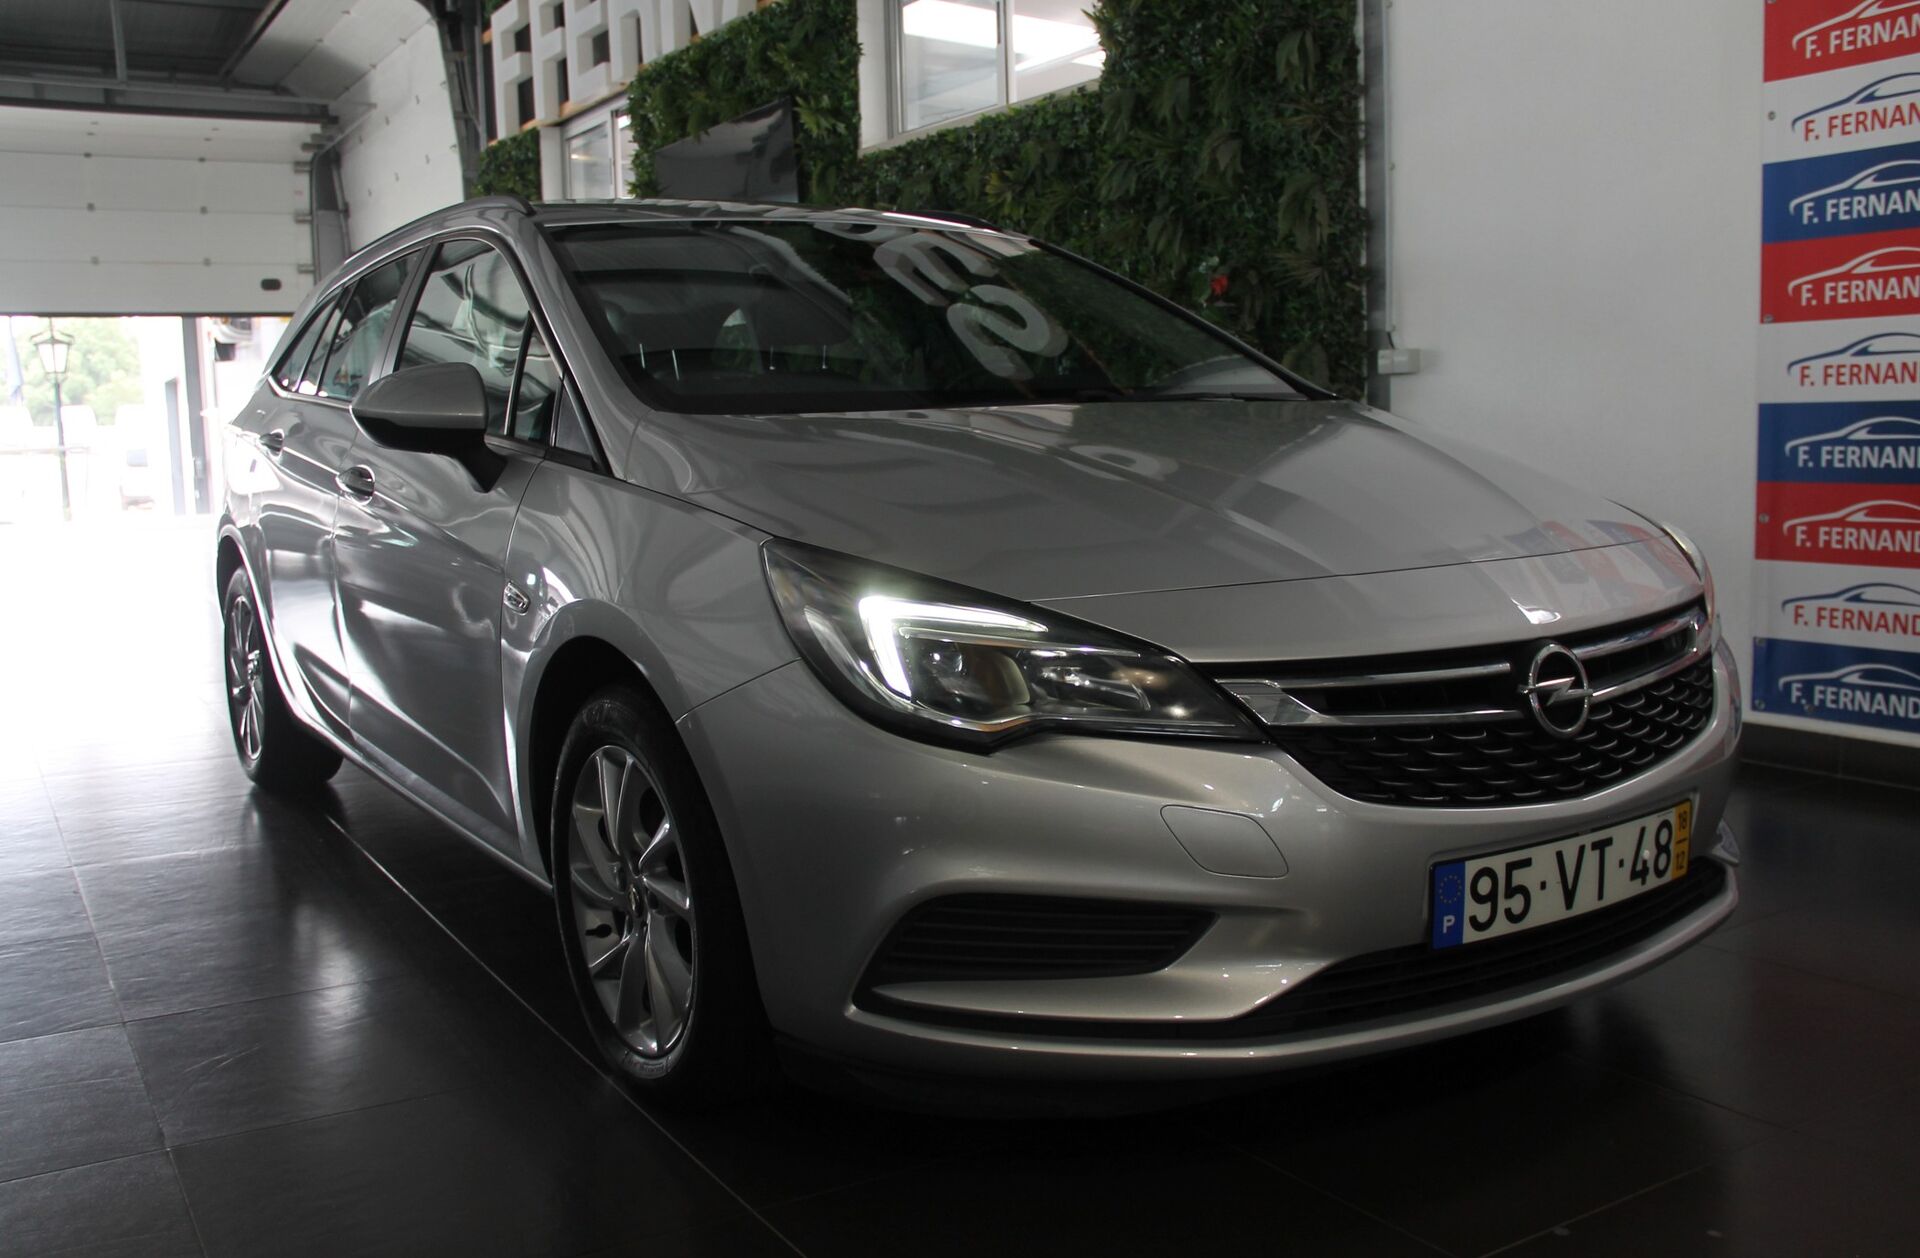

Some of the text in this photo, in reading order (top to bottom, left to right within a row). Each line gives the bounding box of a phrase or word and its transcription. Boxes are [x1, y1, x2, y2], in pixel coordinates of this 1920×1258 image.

[1805, 35, 1822, 59] F.
[1803, 119, 1819, 141] F.
[1802, 201, 1819, 225] F.
[1801, 284, 1817, 306] F.
[1799, 365, 1814, 387] F.
[1797, 445, 1920, 468] F. FERNAN
[1795, 526, 1811, 547] F.
[1793, 604, 1809, 626] F.
[1790, 682, 1806, 705] F.
[1442, 915, 1455, 934] P
